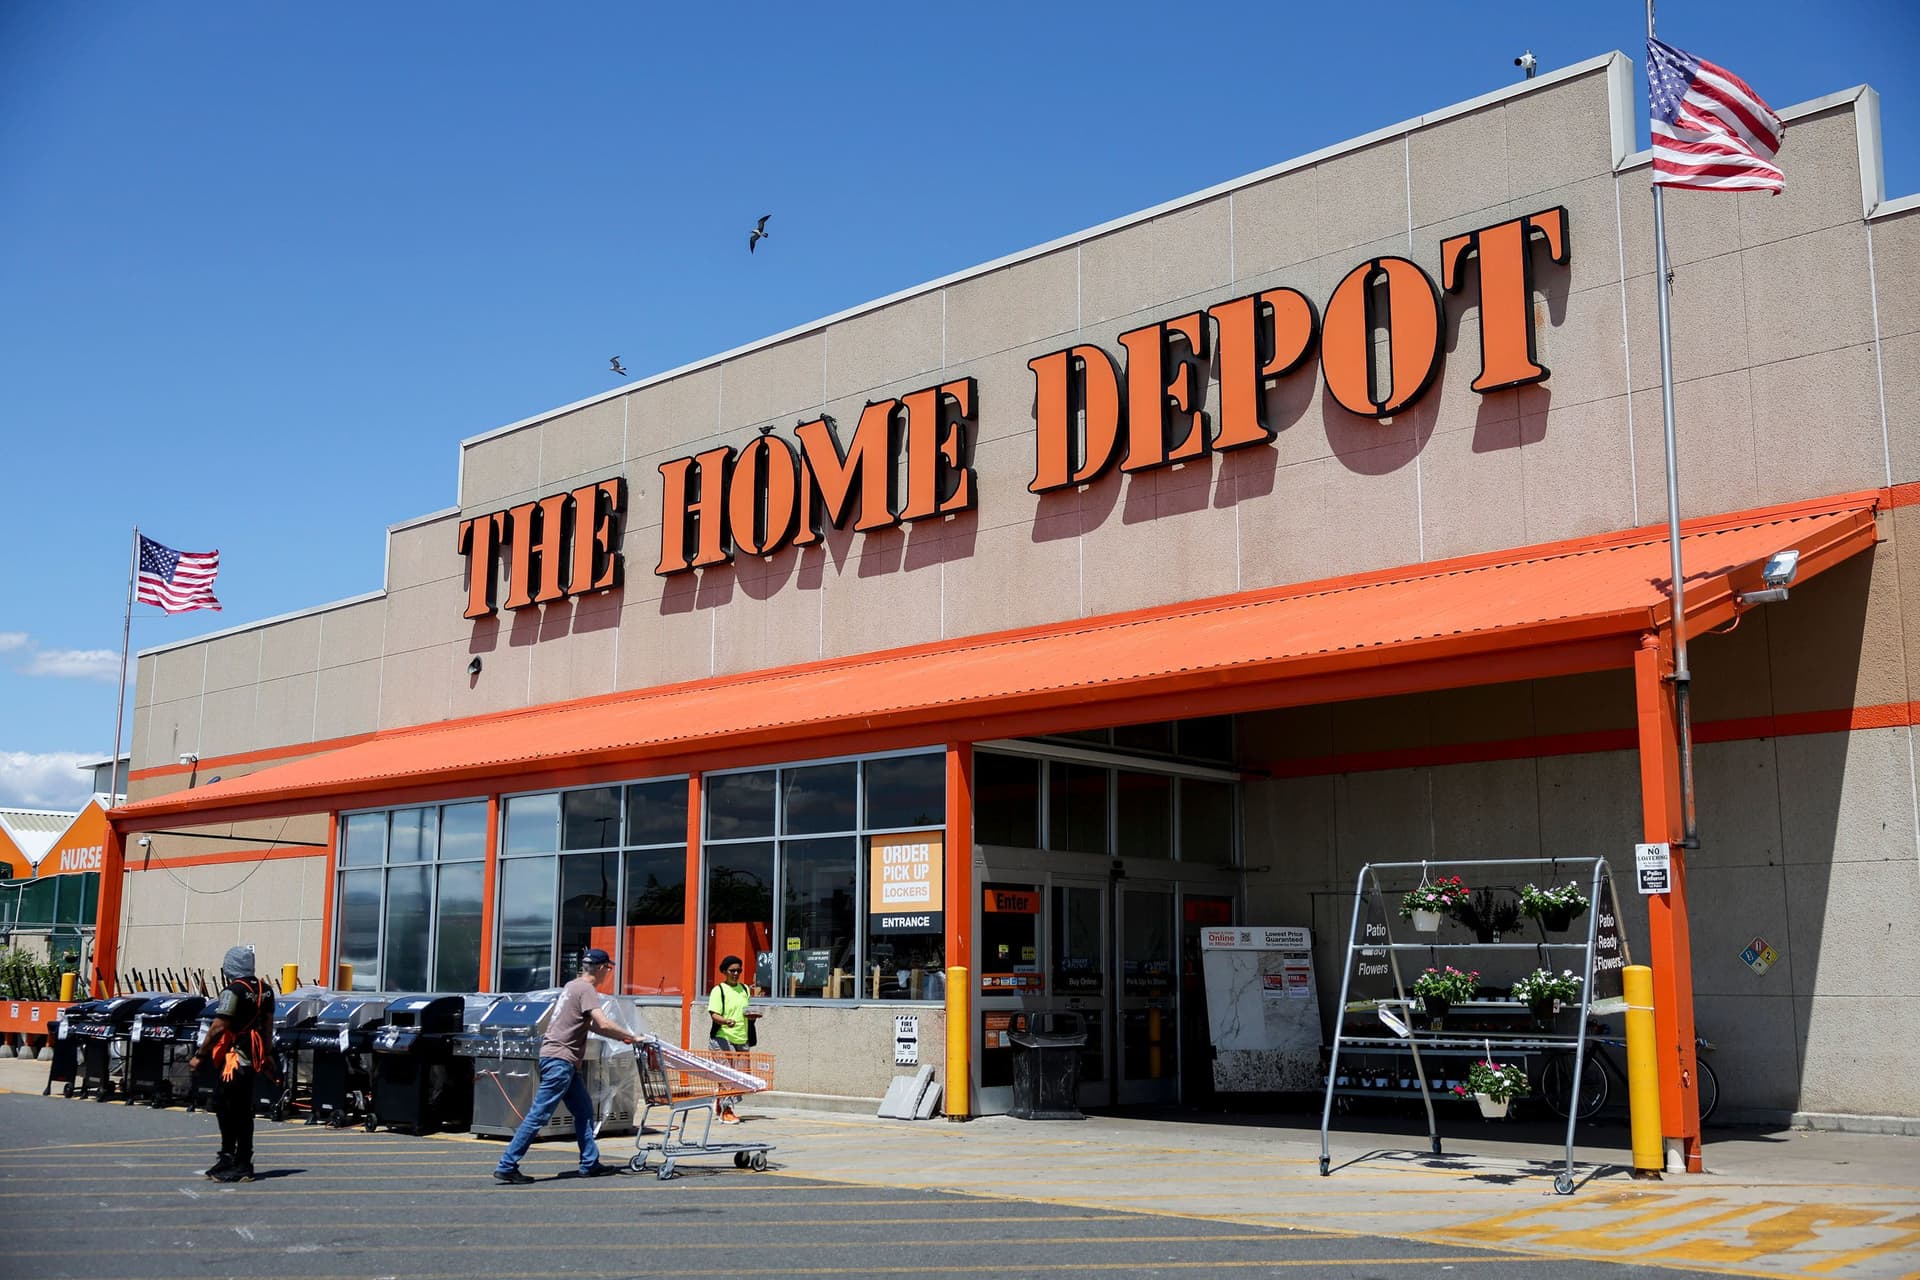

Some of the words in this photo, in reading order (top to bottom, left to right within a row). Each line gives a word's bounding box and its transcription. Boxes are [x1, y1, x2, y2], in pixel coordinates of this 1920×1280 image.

[458, 477, 628, 619] THE
[654, 376, 977, 577] HOME
[1027, 205, 1569, 495] DEPOT
[883, 844, 929, 864] ORDER
[883, 865, 910, 881] PICK
[914, 864, 929, 880] UP
[885, 887, 928, 898] LOCKERS
[996, 893, 1029, 911] Enter
[882, 917, 930, 928] ENTRANCE
[1599, 914, 1615, 928] Patio
[1366, 923, 1386, 937] Patio
[1208, 934, 1235, 942] Online
[1598, 934, 1617, 950] Ready
[1358, 963, 1389, 976] Flowers
[1597, 957, 1622, 970] Flowers
